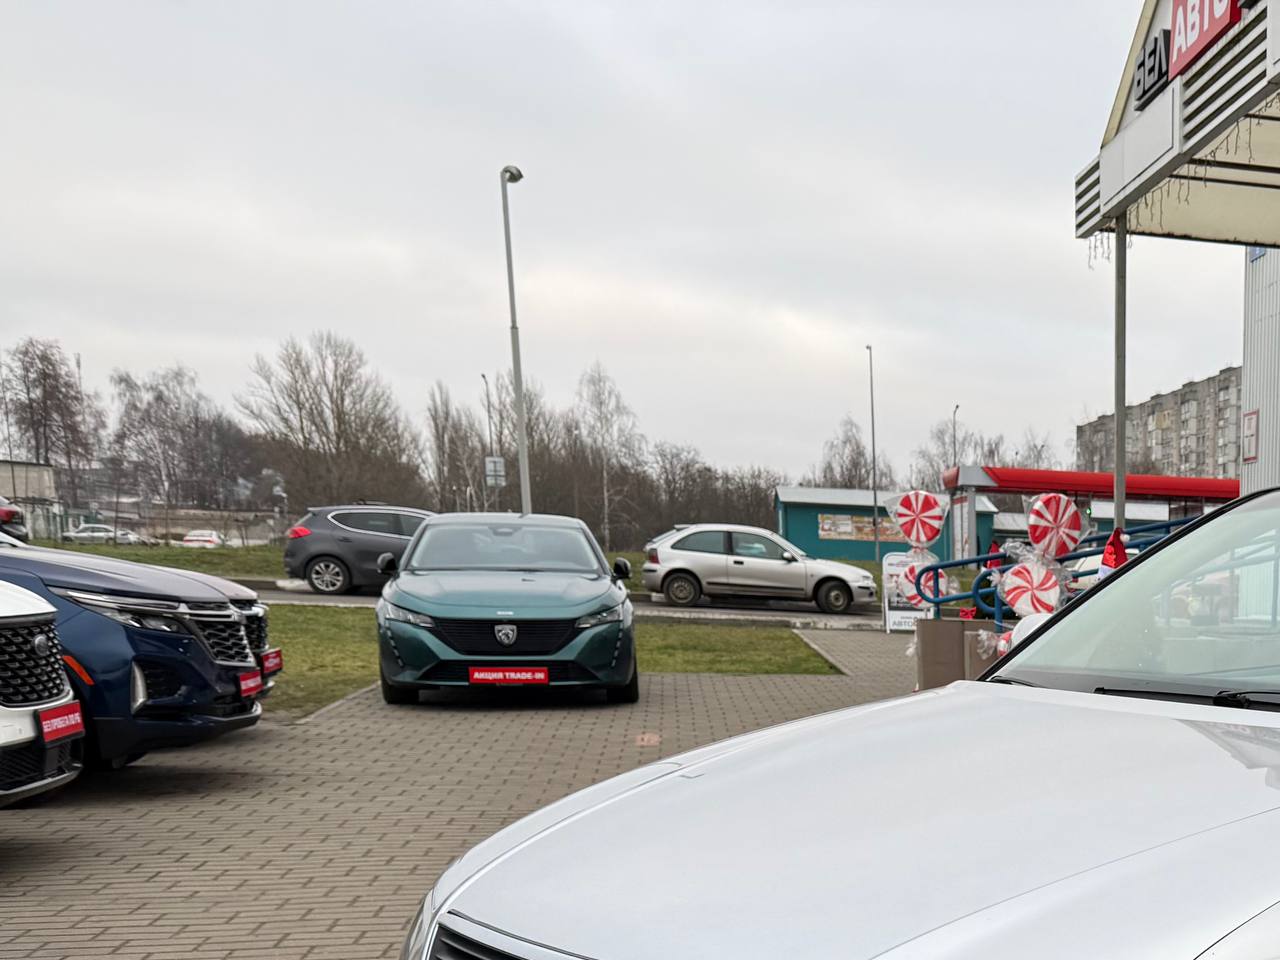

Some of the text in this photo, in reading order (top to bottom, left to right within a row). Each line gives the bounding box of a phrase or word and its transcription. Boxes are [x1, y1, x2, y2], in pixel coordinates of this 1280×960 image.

[1134, 29, 1169, 101] БЕЛ
[473, 671, 545, 680] АКЦИЯ TRADE-IN
